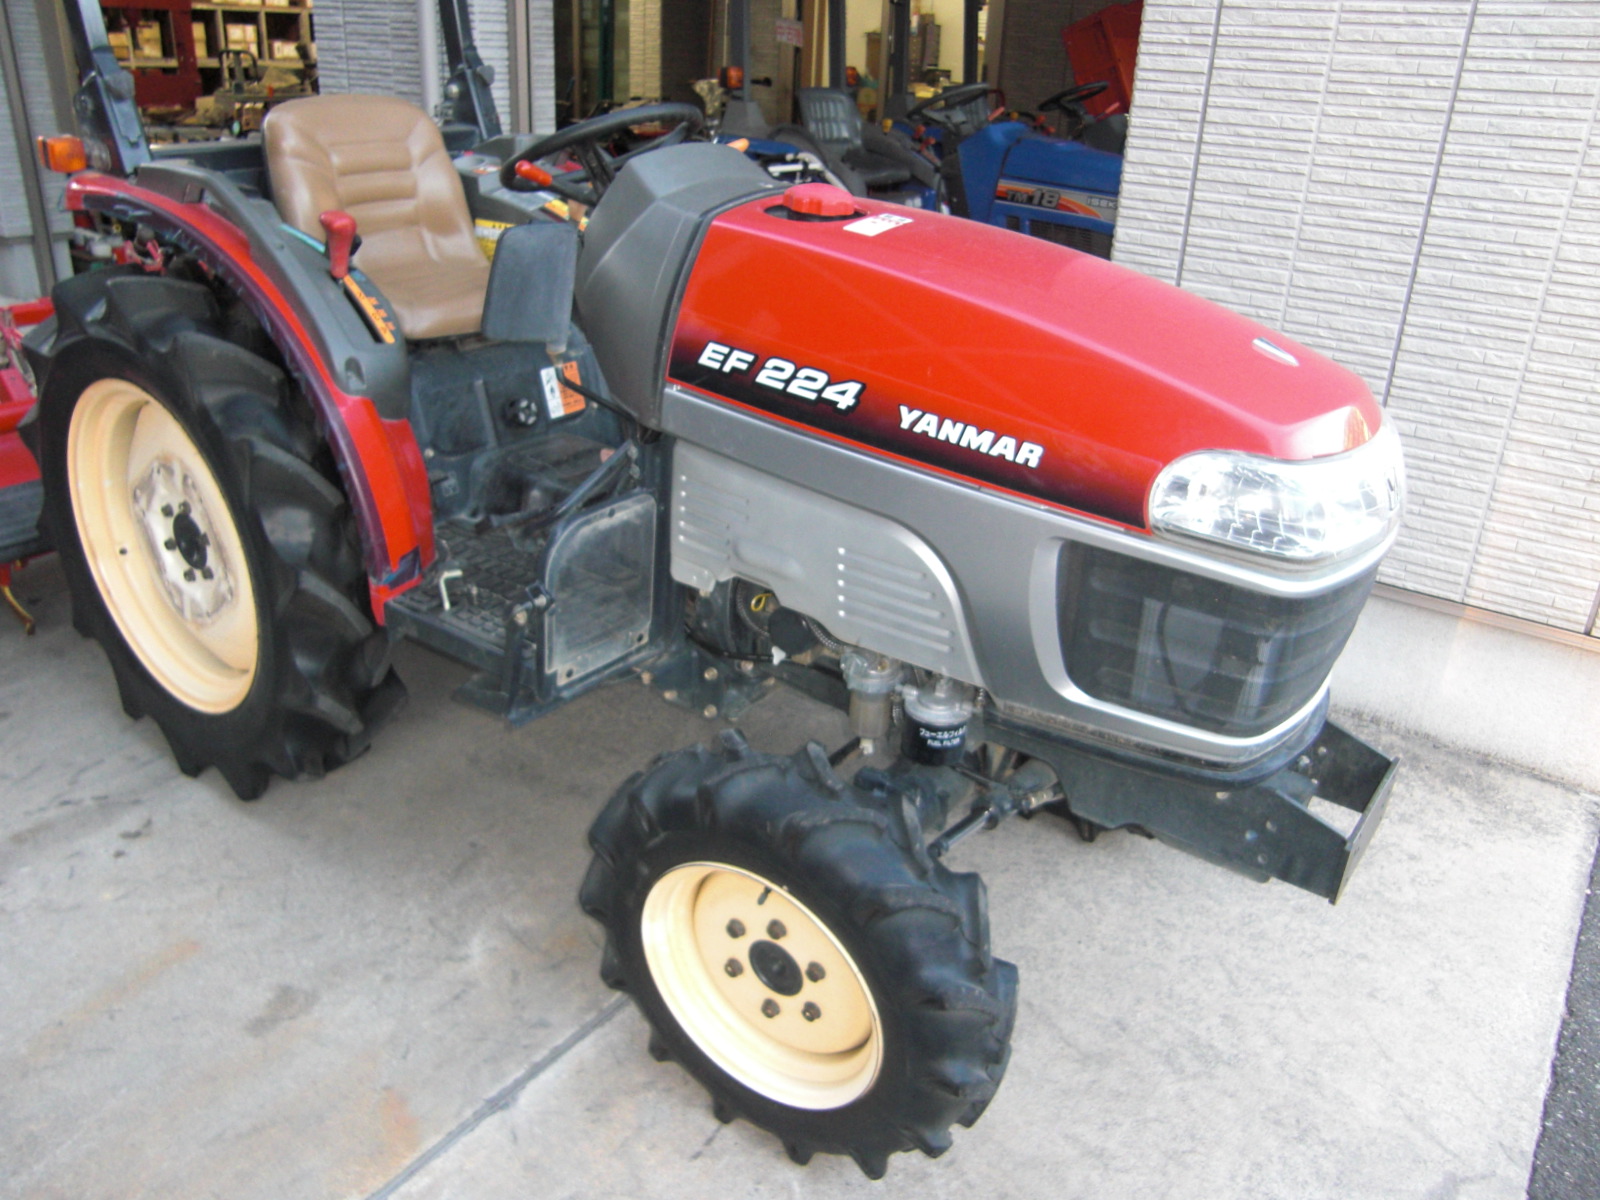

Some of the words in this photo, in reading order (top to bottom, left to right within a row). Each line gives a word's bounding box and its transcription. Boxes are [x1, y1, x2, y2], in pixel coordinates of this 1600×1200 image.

[1086, 195, 1117, 210] ISEK
[697, 341, 756, 374] EF
[755, 357, 864, 411] 224
[898, 404, 1045, 469] YANMAR
